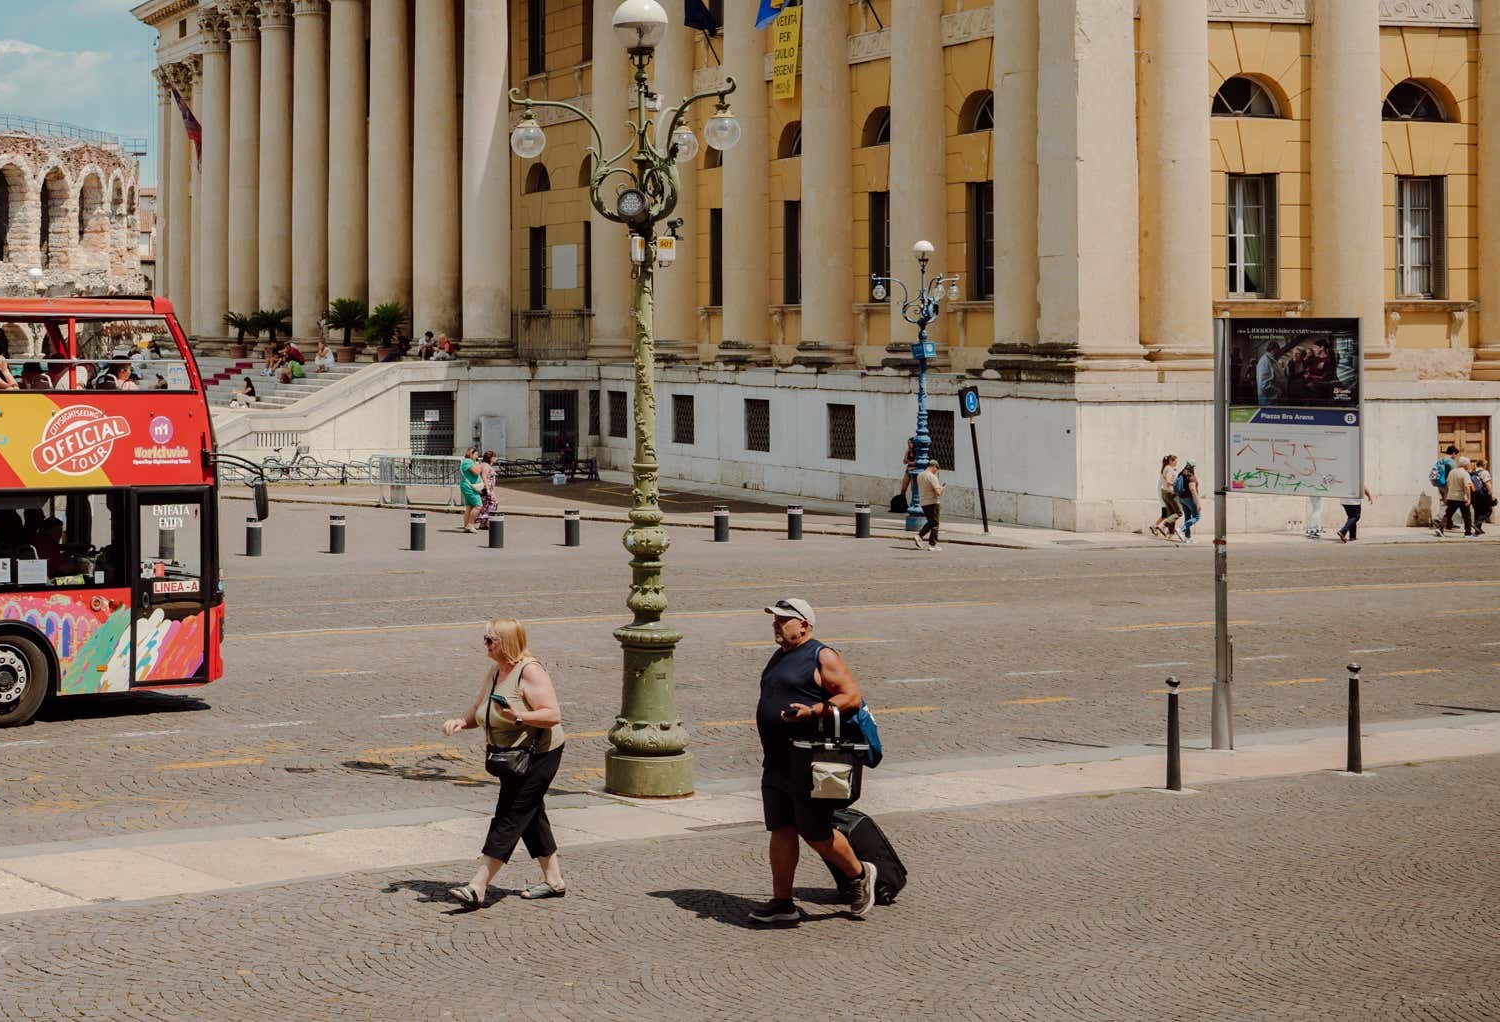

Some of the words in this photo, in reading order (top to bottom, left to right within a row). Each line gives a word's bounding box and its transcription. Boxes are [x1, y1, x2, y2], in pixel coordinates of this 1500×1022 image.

[779, 31, 791, 43] PER
[50, 409, 99, 435] CITYSIGHTSEEING
[1260, 412, 1281, 420] Piazza
[41, 419, 126, 466] OFFICIAL
[71, 446, 108, 470] TOUR
[153, 504, 190, 516] ENTRATA
[159, 517, 183, 528] ENTRY
[154, 582, 184, 593] LINEA
